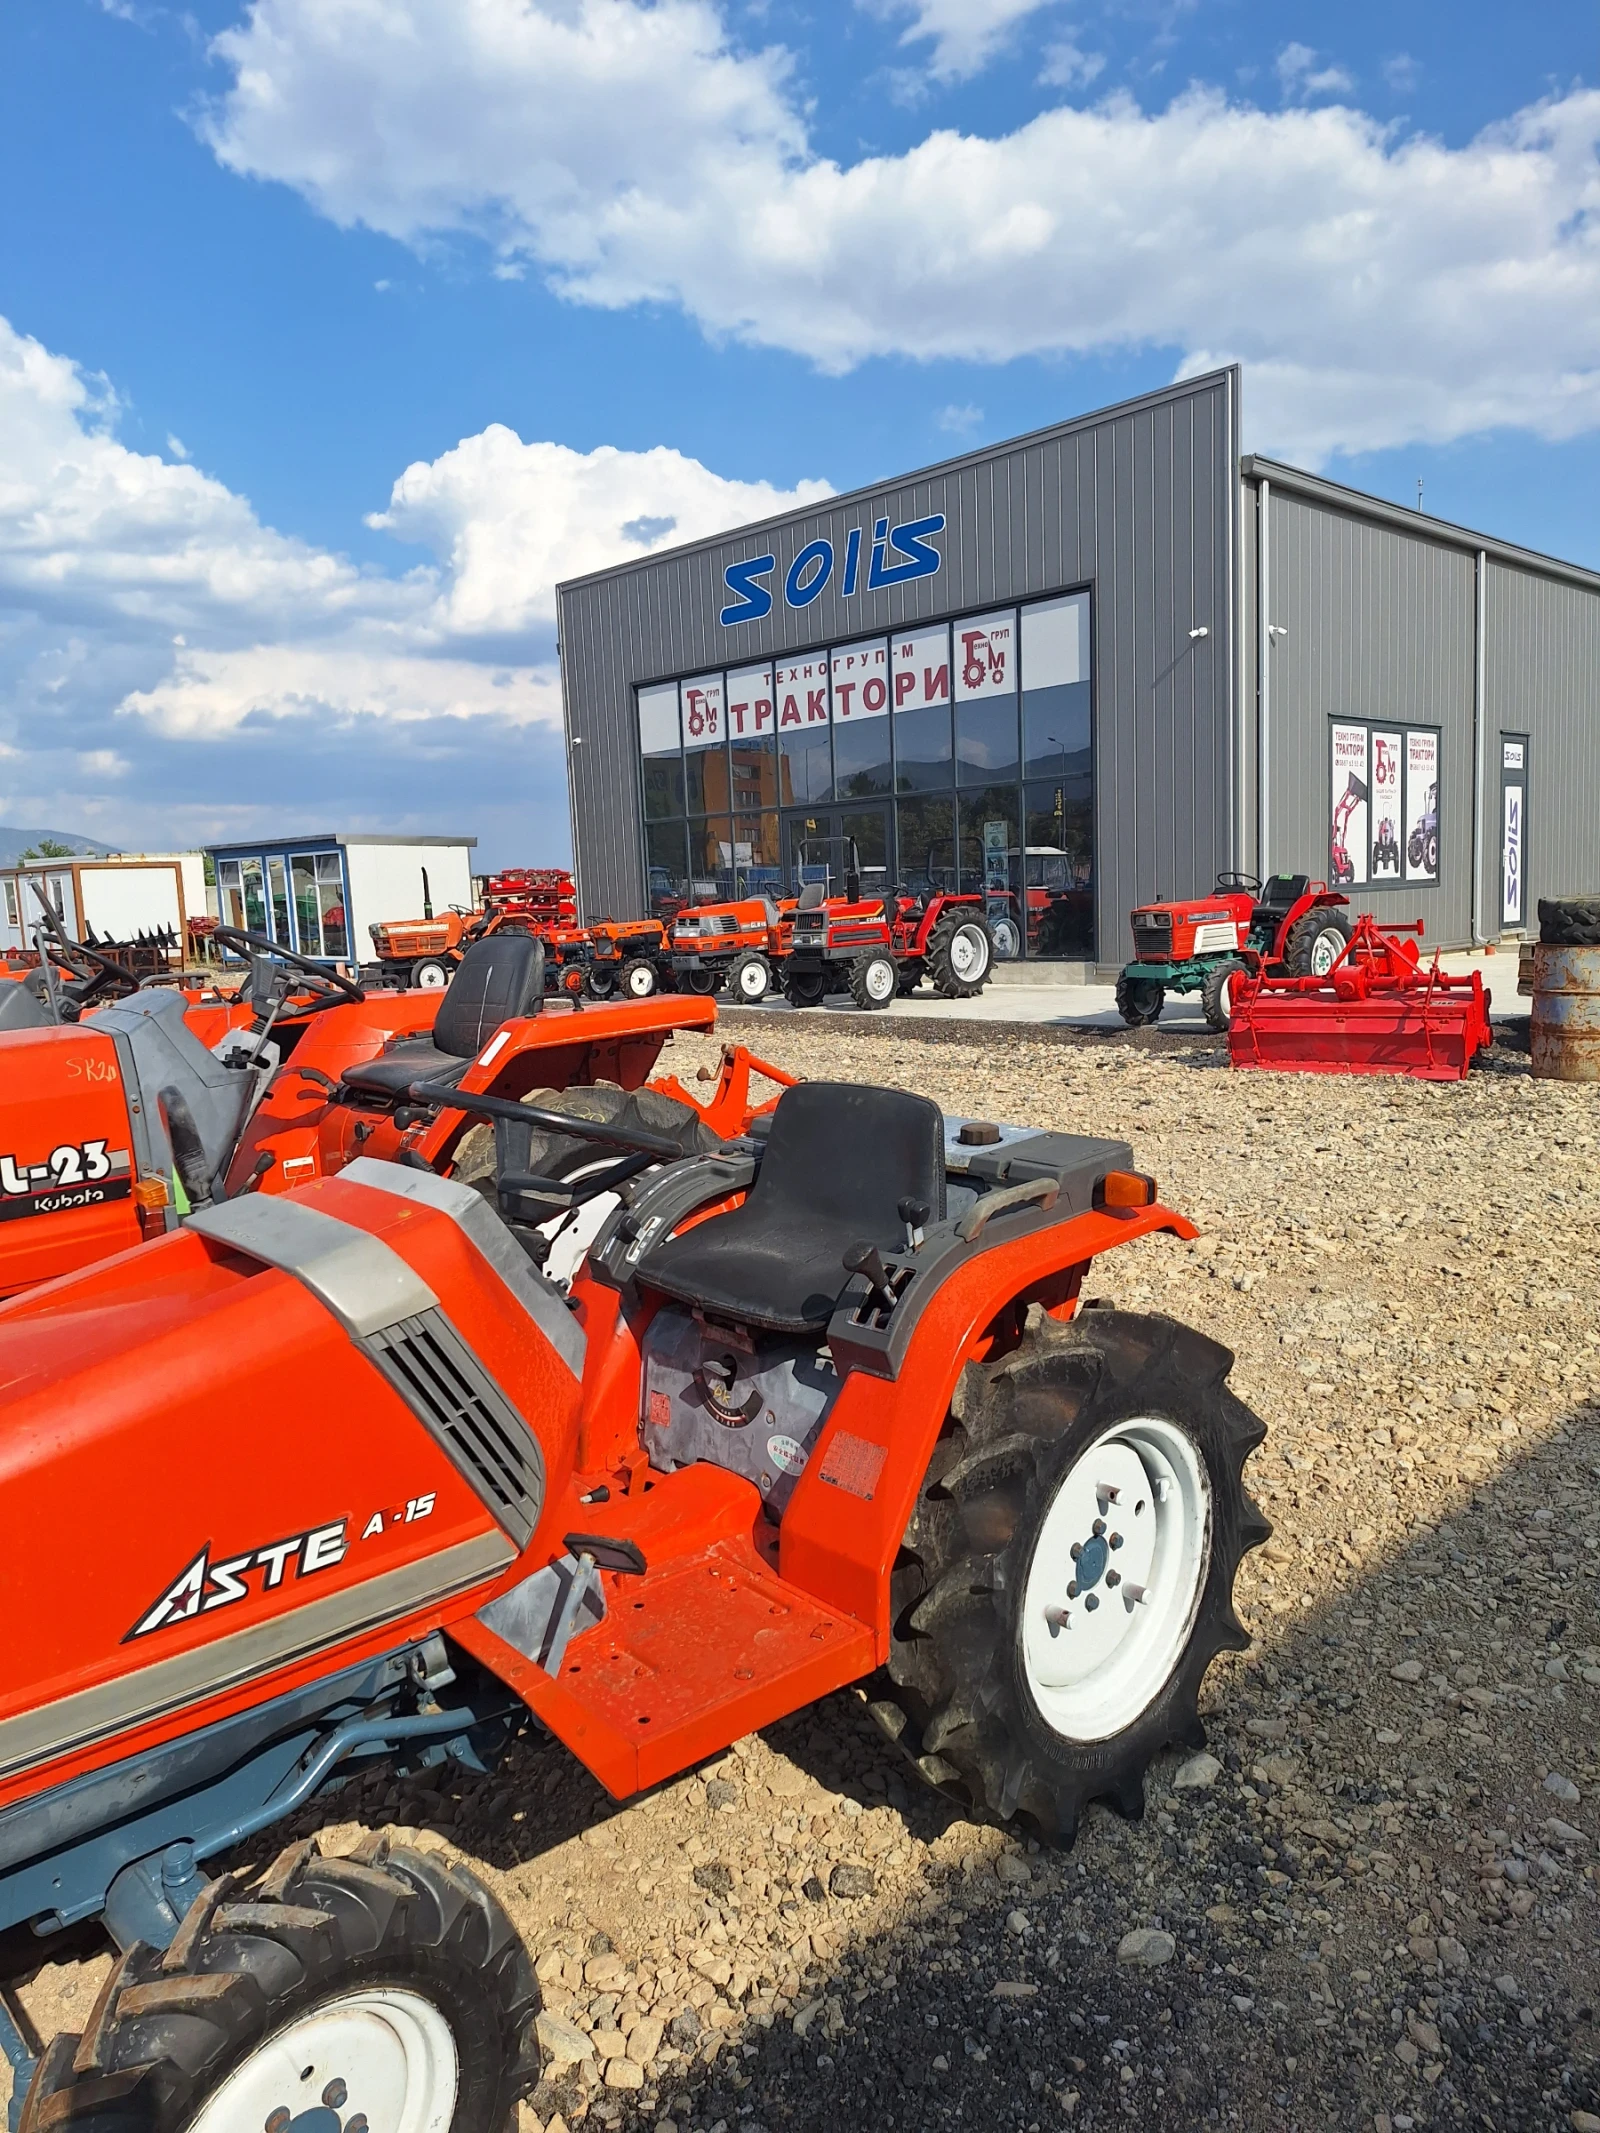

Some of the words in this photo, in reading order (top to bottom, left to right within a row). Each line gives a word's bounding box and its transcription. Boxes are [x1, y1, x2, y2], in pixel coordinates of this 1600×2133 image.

[730, 663, 949, 734] ТРАКТОРИ
[1335, 742, 1365, 757] ТРАКТОРИ
[1409, 748, 1435, 761] ТРАКТОРИ
[34, 1188, 105, 1211] Kubota
[361, 1492, 437, 1540] A-15
